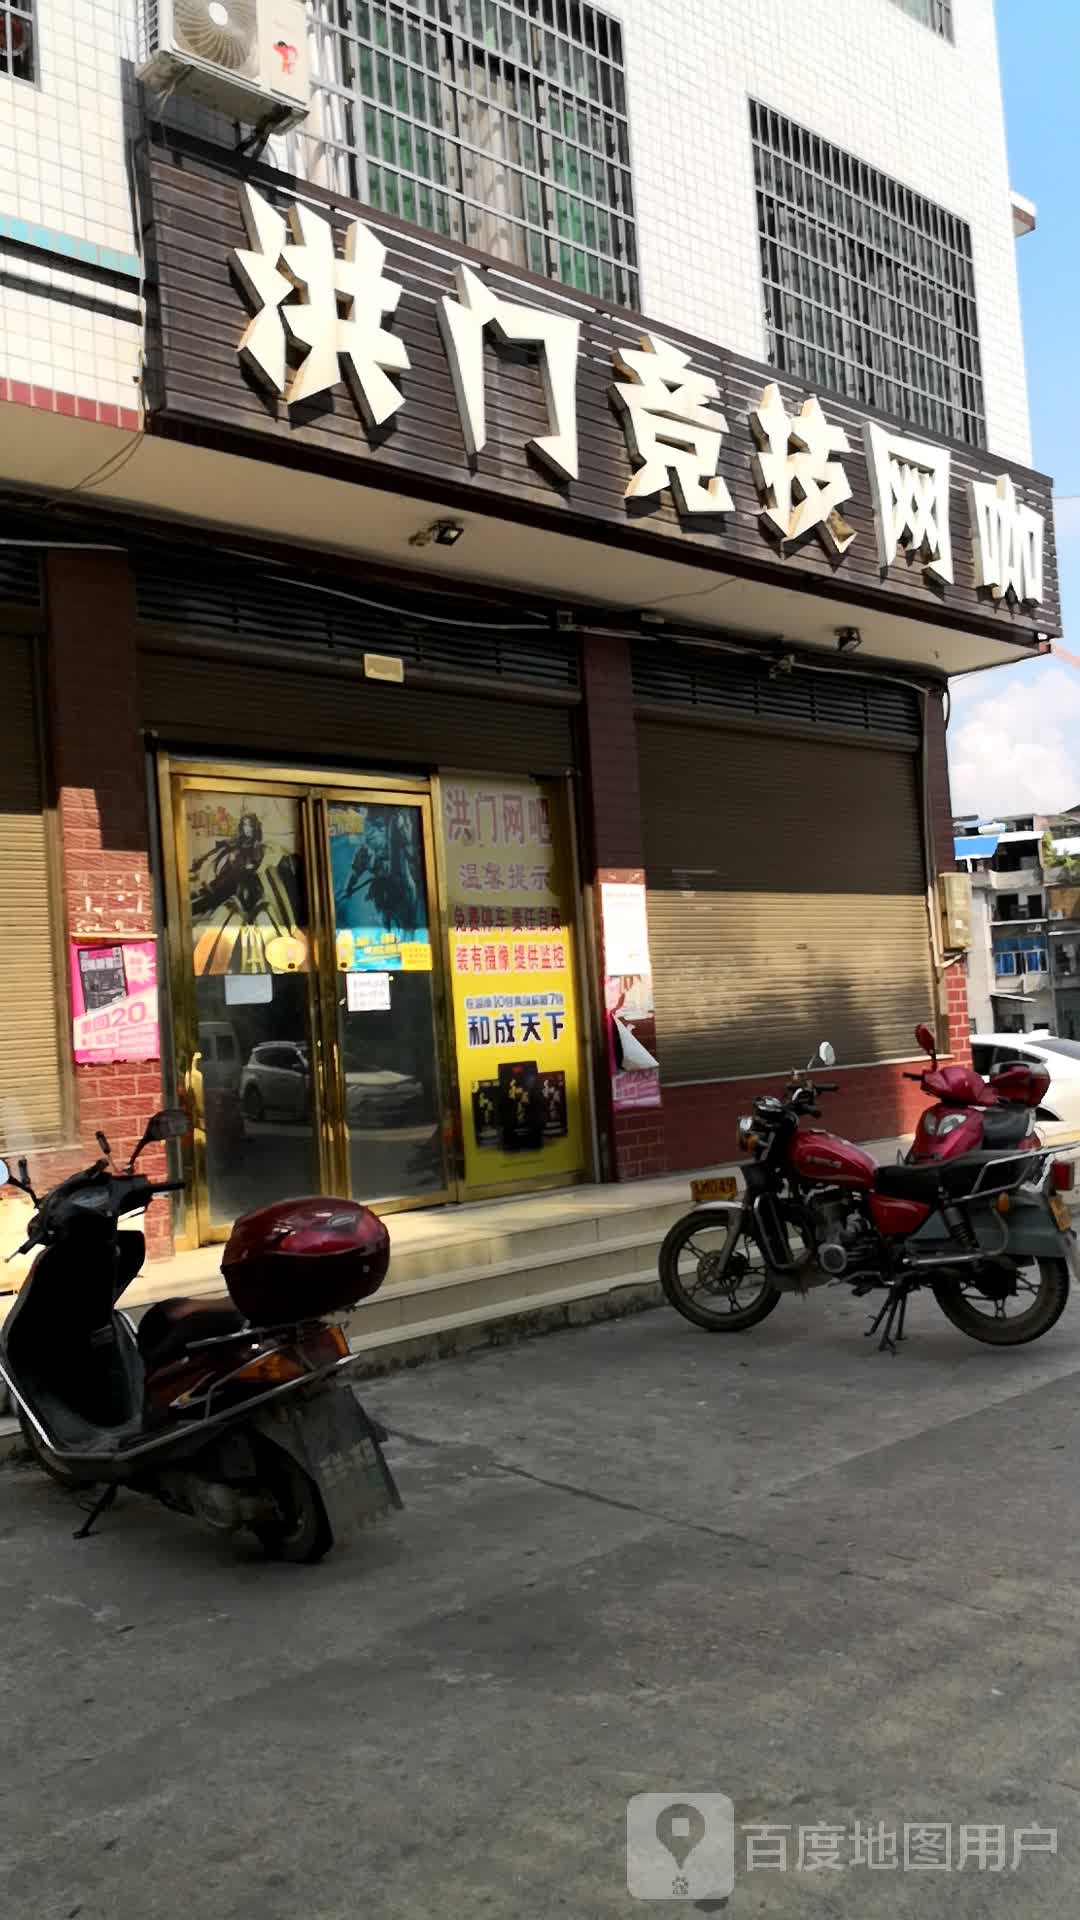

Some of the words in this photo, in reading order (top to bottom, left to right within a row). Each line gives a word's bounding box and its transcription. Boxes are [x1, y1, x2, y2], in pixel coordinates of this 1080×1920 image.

[228, 183, 1044, 604] 洪门竞技网咖
[446, 788, 553, 846] 洪门网吧
[467, 1011, 565, 1047] 和成天下
